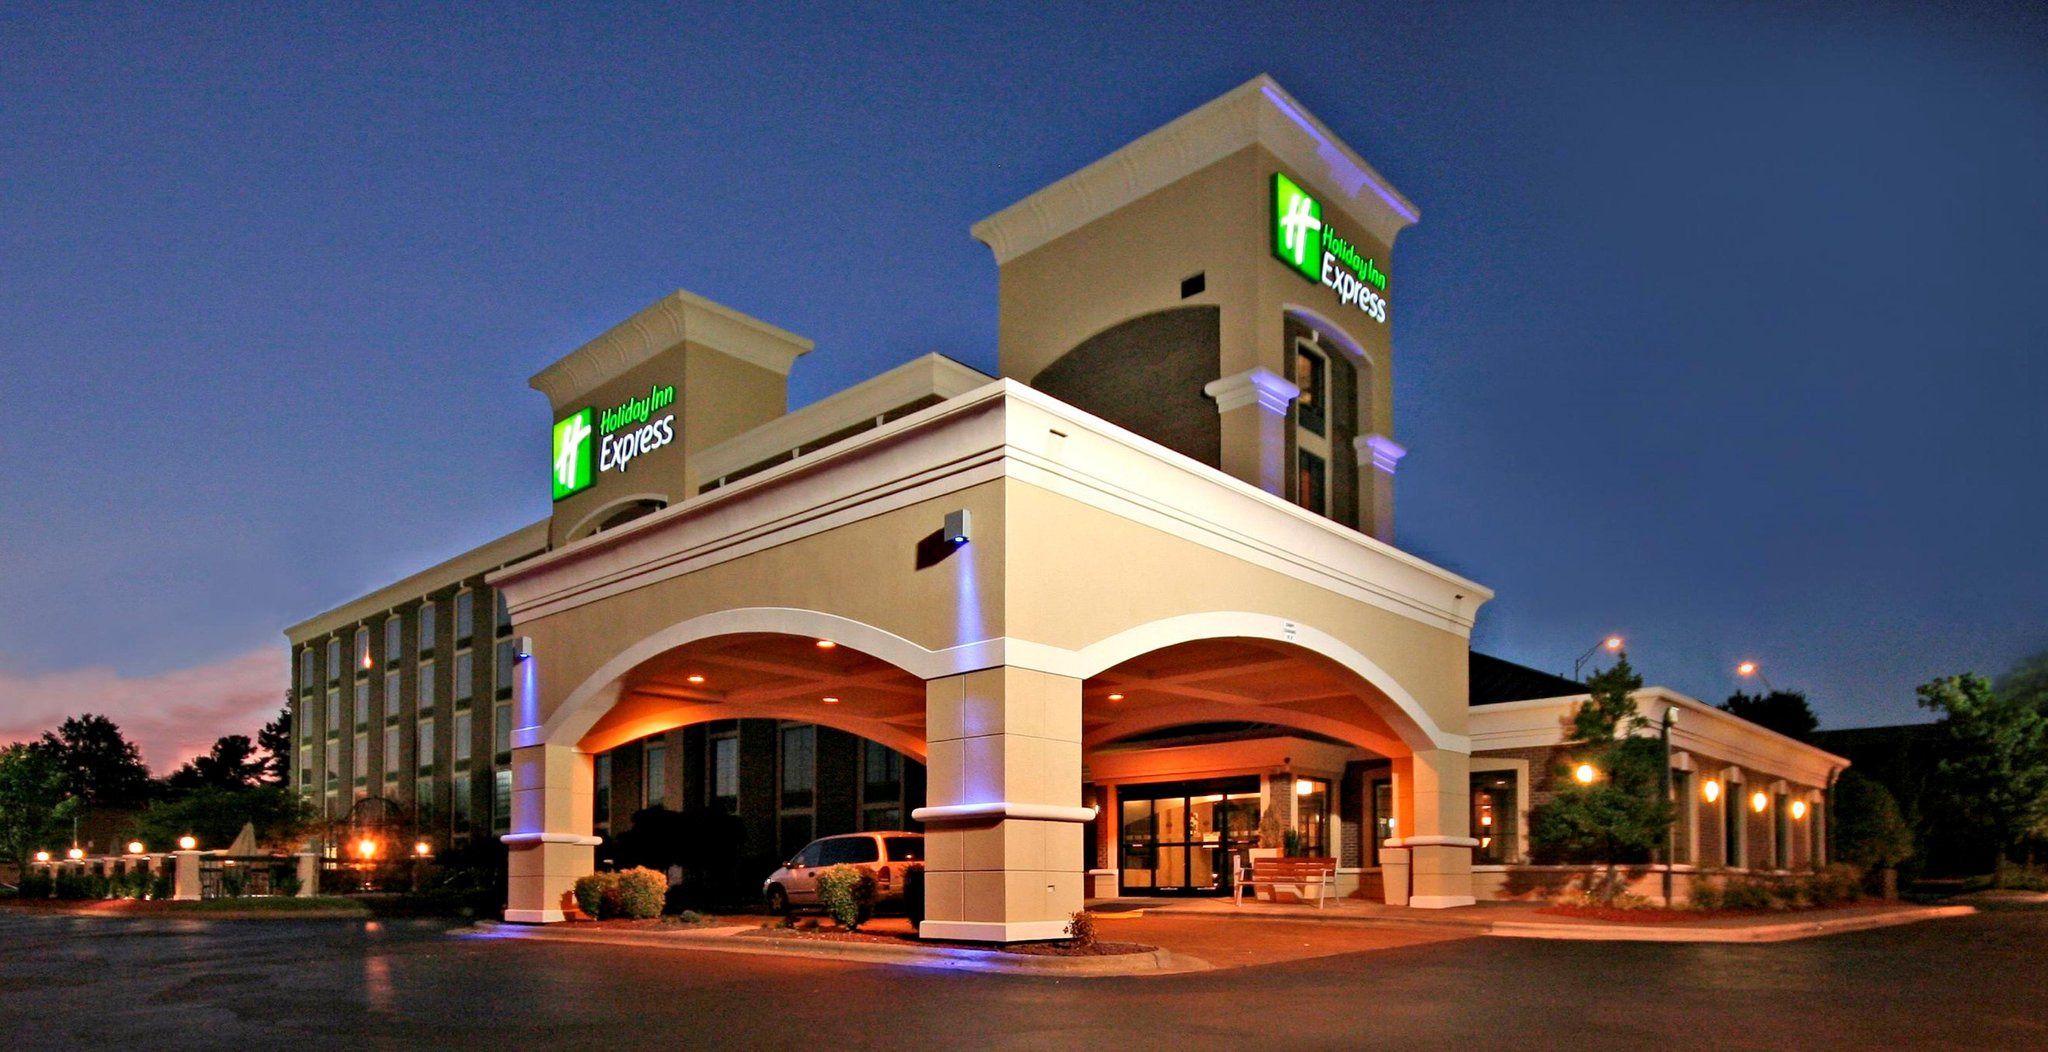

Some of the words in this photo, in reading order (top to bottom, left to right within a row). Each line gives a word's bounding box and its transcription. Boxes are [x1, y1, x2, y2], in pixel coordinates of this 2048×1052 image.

[1322, 251, 1386, 323] Express
[1323, 224, 1368, 281] Holiday
[1368, 258, 1386, 291] Inn
[600, 397, 650, 435] Holiday
[650, 385, 673, 411] Inn
[600, 414, 674, 472] Express
